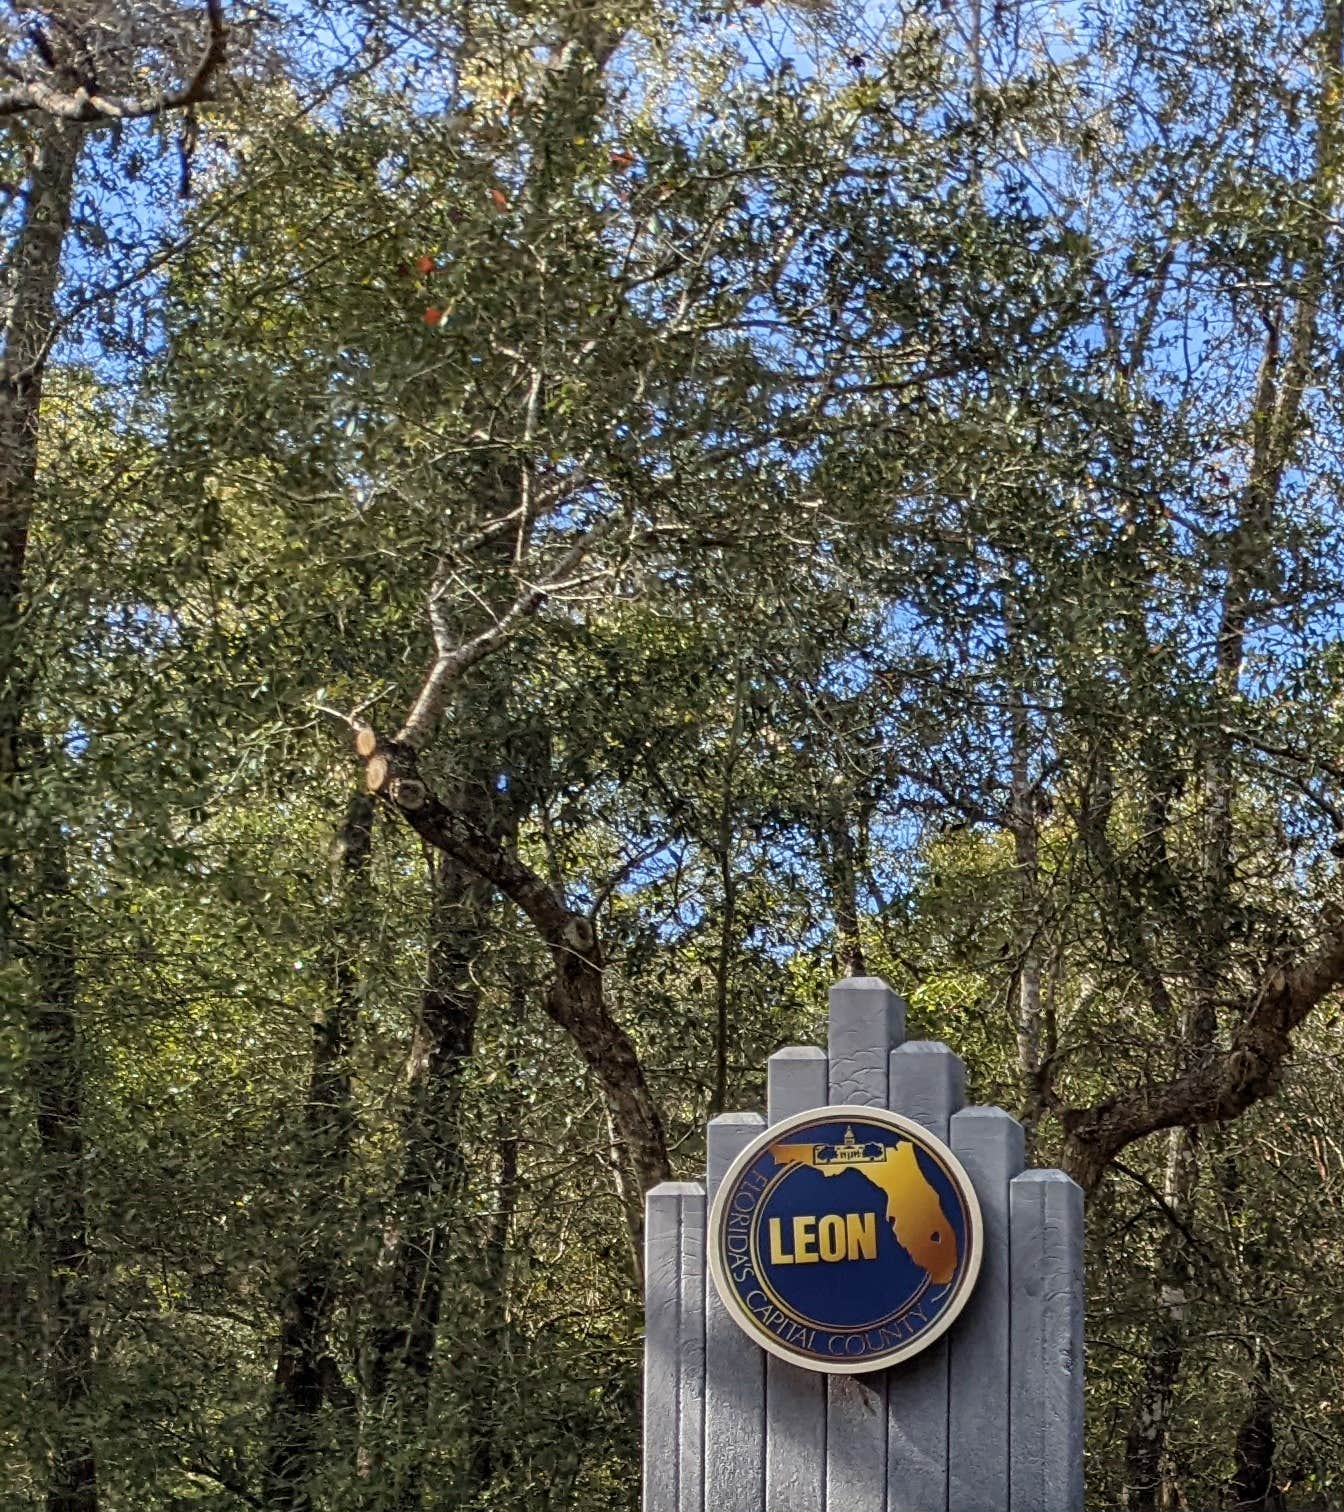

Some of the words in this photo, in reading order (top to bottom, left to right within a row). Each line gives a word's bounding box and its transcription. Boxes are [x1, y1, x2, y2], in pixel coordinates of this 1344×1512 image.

[727, 1170, 768, 1282] FLORIDA'S
[768, 1213, 878, 1265] LEON
[746, 1290, 817, 1350] CAPITAL
[828, 1303, 928, 1356] COUNTY
